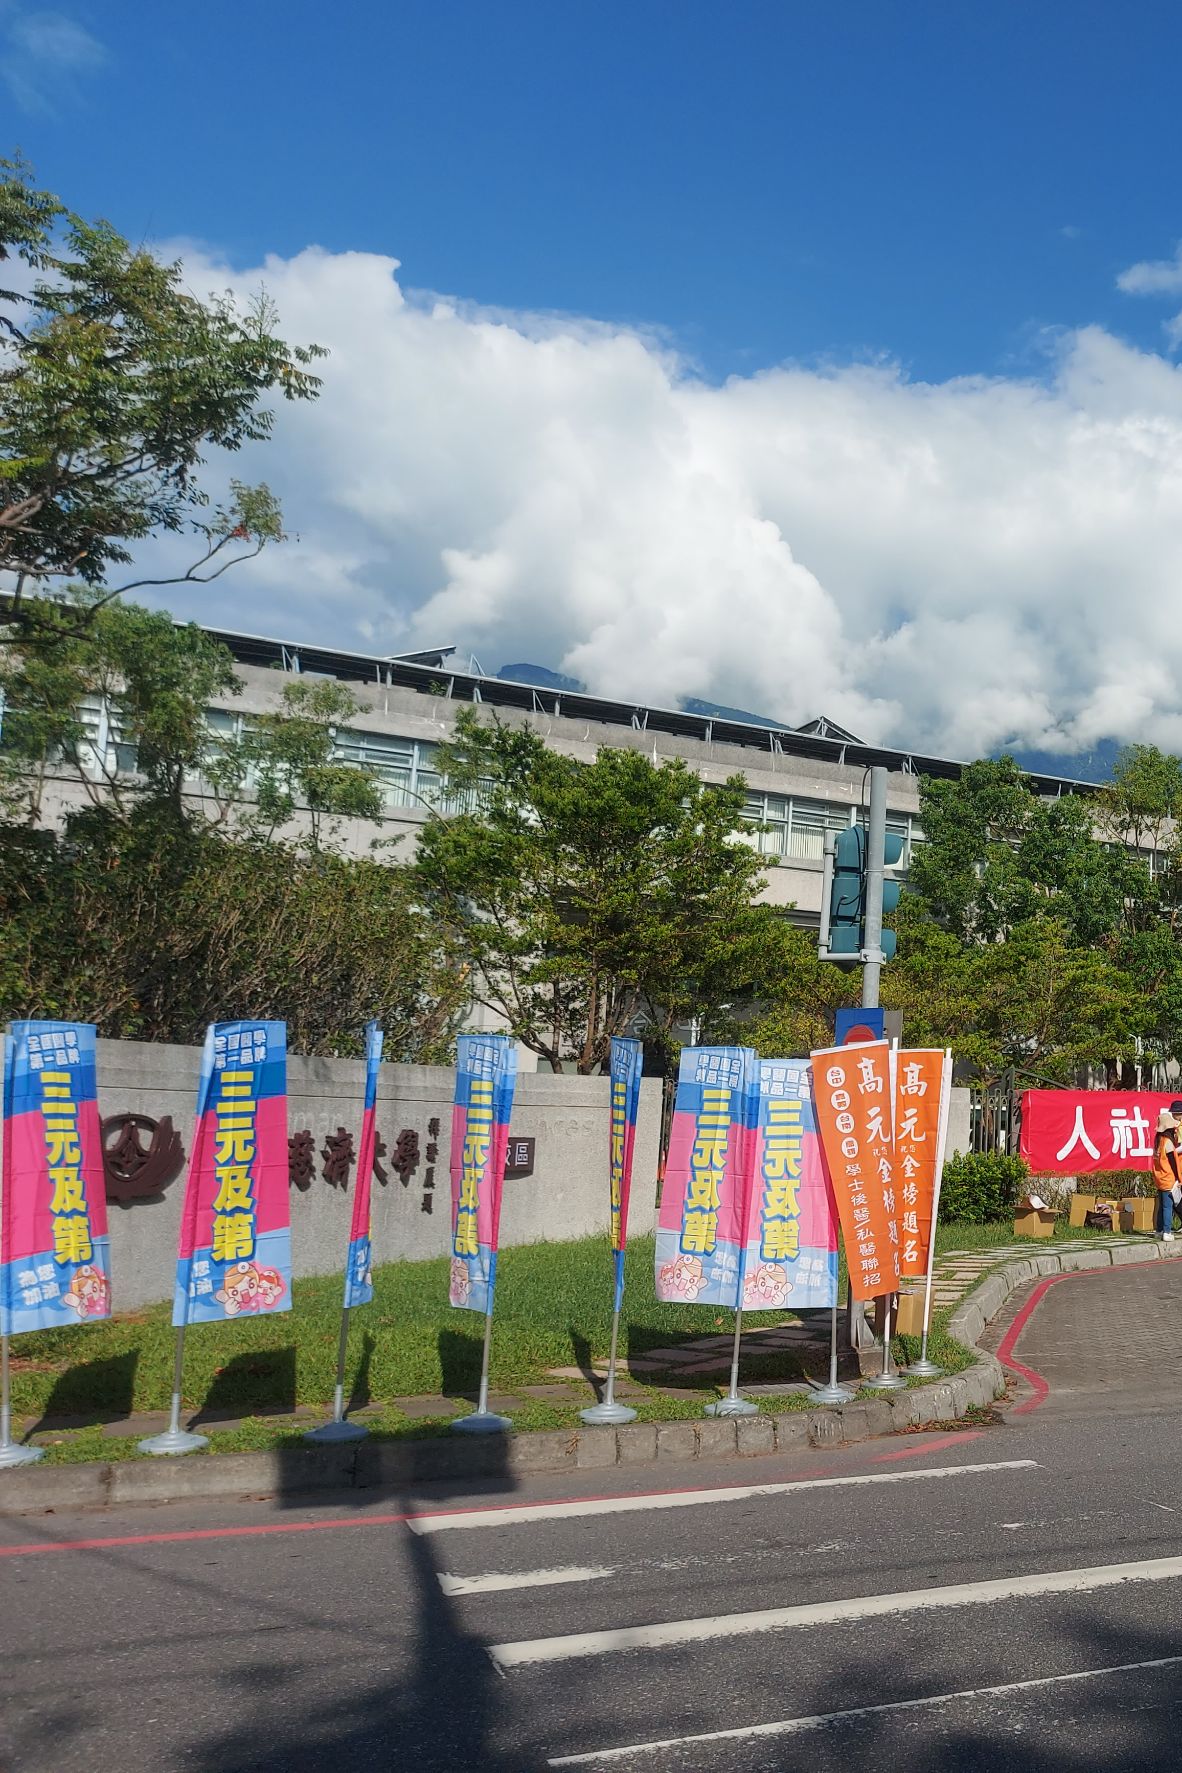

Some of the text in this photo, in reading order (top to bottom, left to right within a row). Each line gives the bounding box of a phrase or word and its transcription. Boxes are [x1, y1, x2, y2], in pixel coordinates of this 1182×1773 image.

[856, 1057, 892, 1144] 高元
[898, 1062, 928, 1142] 高元
[40, 1071, 93, 1264] 三元及第
[211, 1071, 256, 1262] 三元及第
[900, 1155, 921, 1263] 金榜題名
